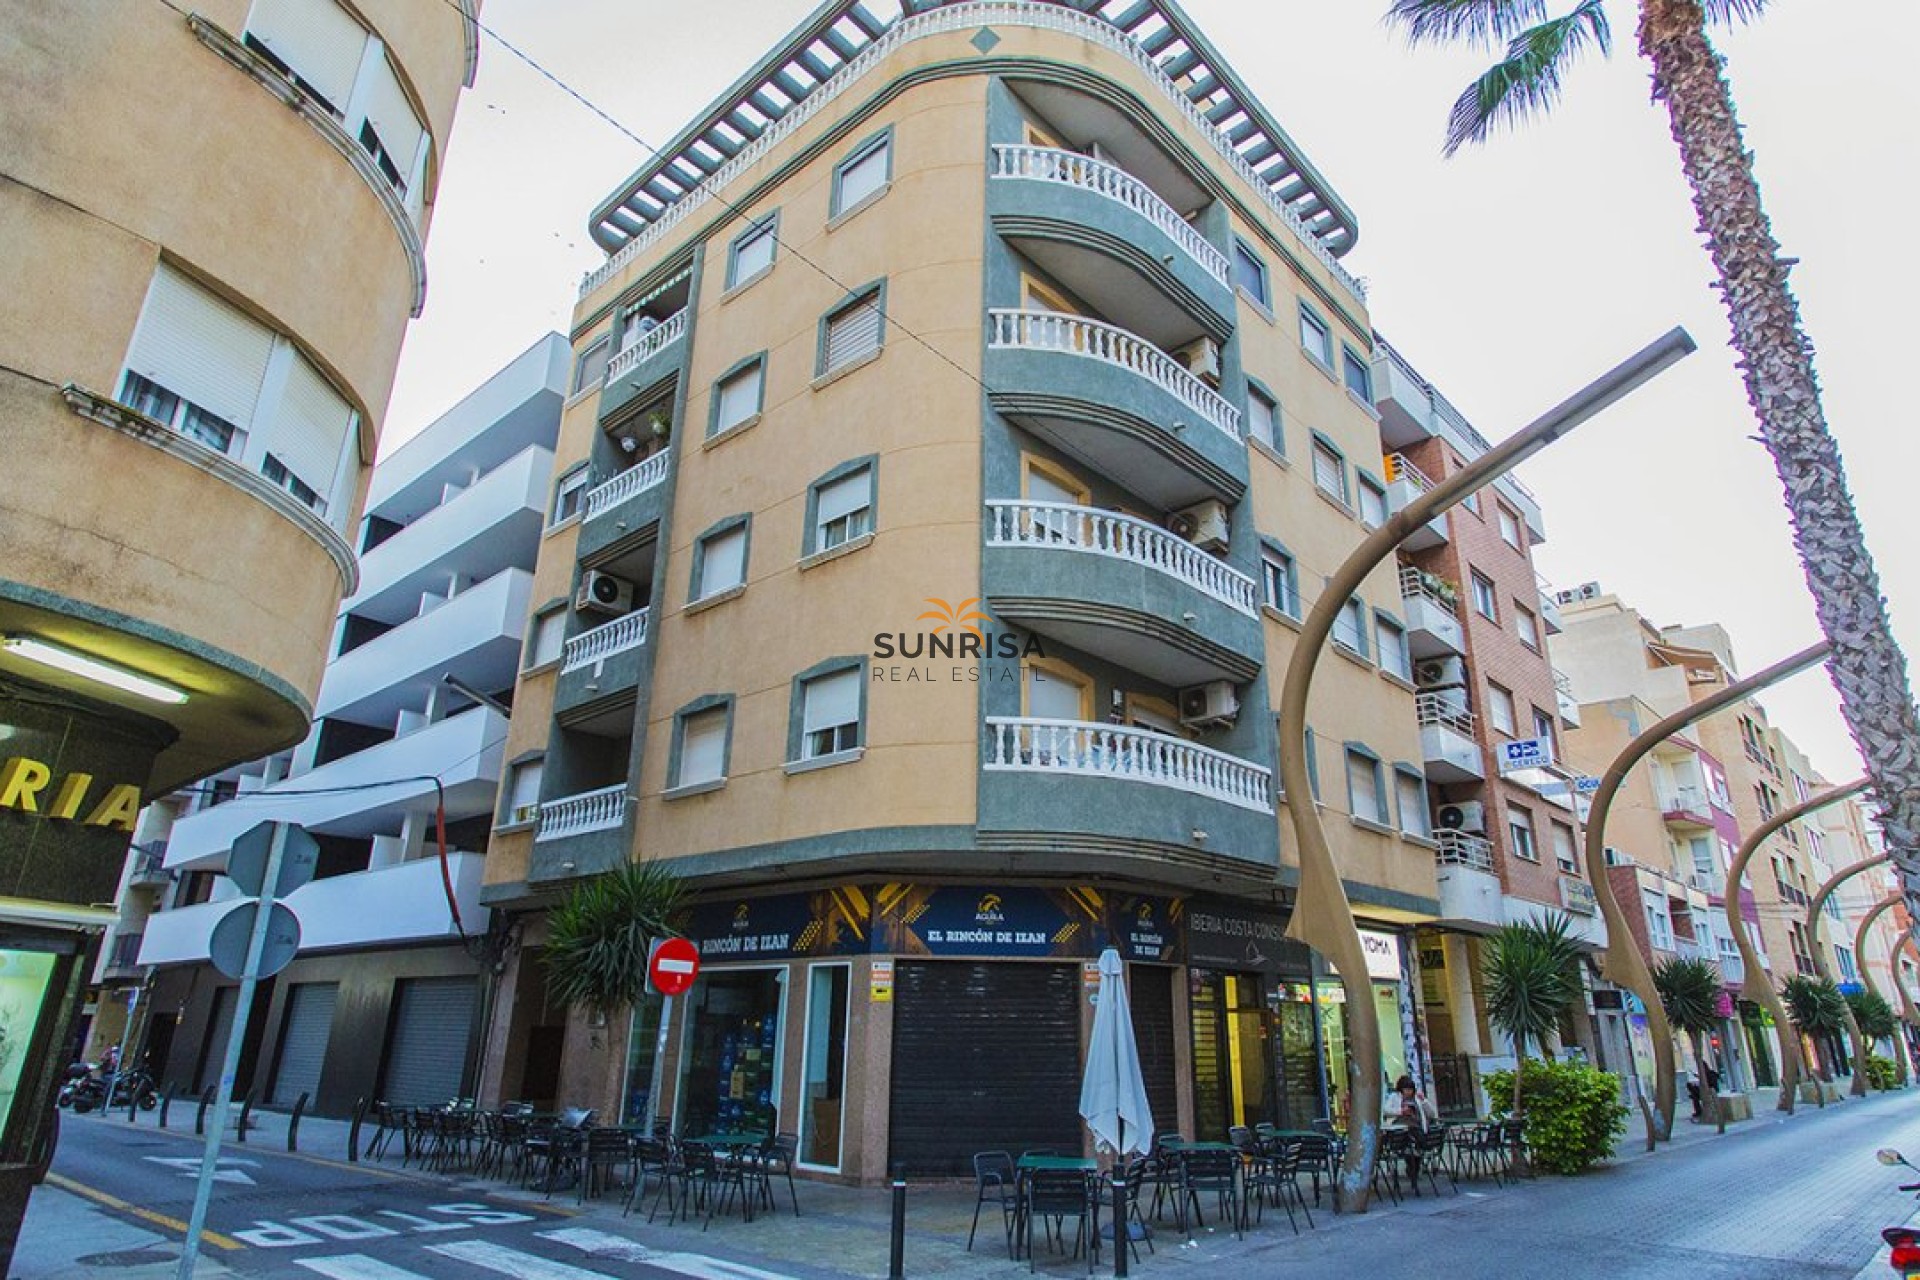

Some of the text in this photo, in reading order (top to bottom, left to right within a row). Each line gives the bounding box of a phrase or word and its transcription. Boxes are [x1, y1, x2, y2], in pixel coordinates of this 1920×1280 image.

[927, 930, 943, 942] EL
[946, 928, 993, 943] RINCÓN
[996, 933, 1012, 943] DE
[1224, 919, 1253, 937] COSTA
[745, 936, 758, 951] DE
